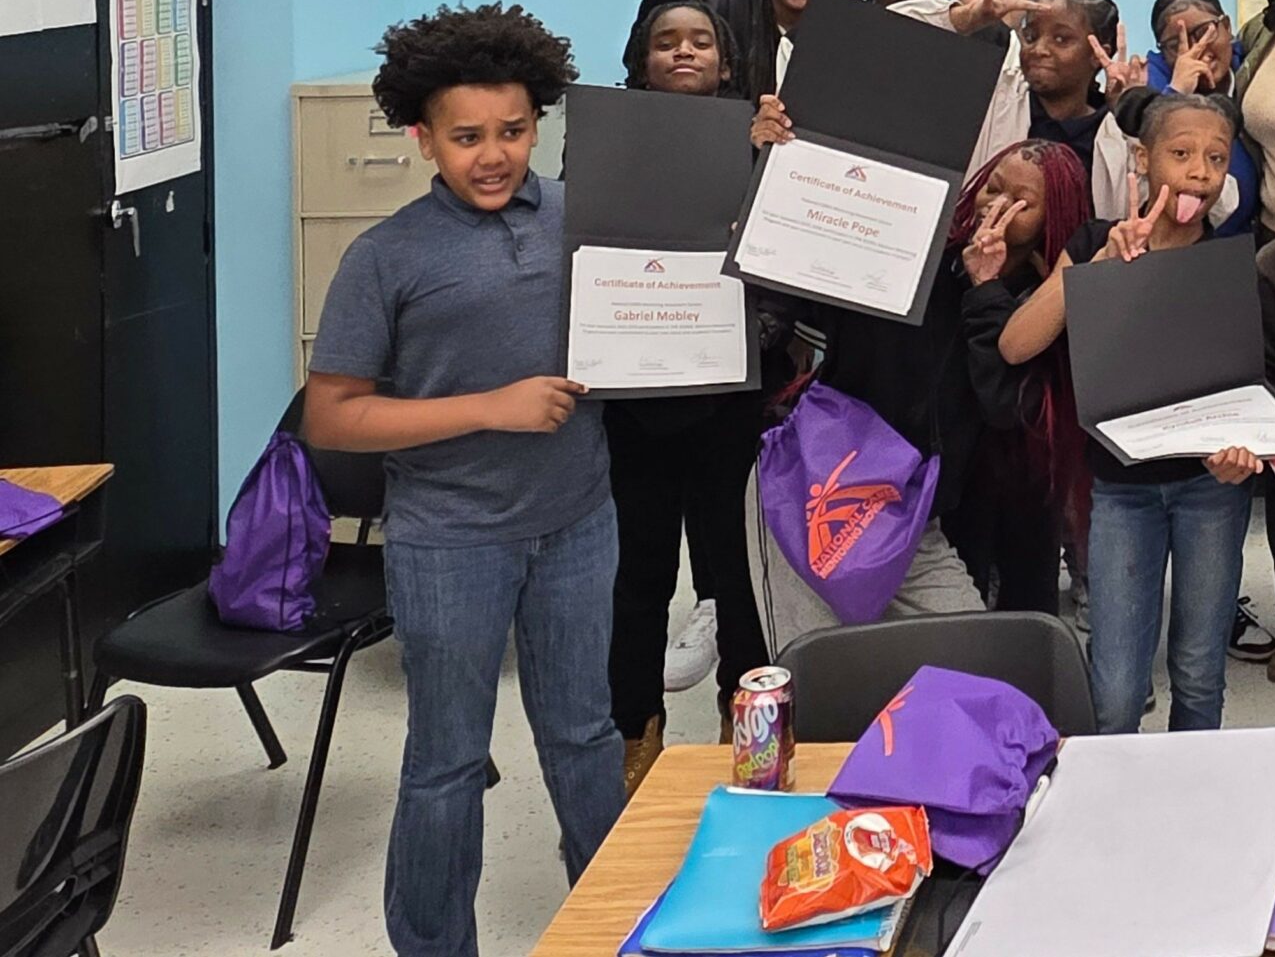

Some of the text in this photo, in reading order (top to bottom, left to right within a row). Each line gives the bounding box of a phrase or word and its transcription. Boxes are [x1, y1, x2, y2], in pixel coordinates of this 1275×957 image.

[789, 170, 918, 214] Certificate of Achievement
[806, 209, 849, 229] Miracle
[851, 221, 880, 238] Pope
[594, 278, 721, 290] Certificate of Achievement
[614, 310, 700, 323] Gabriel Mobley
[811, 511, 864, 576] NATIONAL
[819, 527, 863, 579] MENTORING
